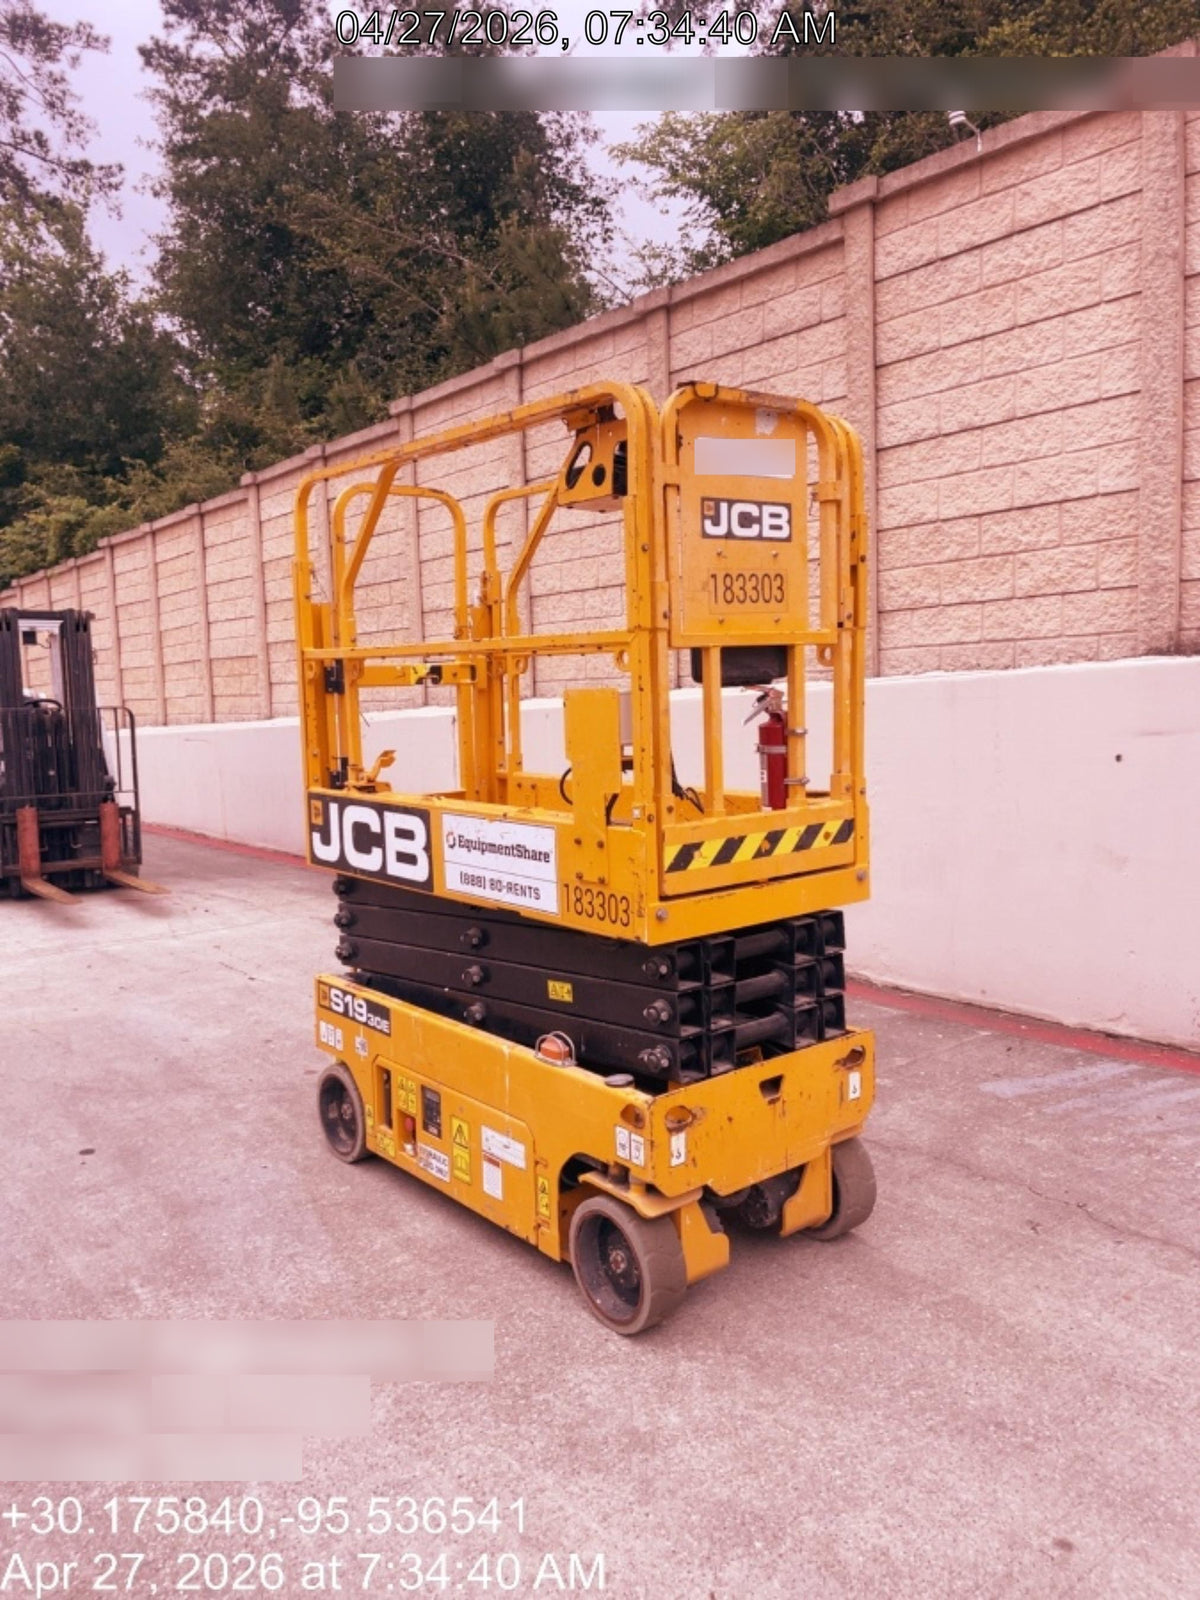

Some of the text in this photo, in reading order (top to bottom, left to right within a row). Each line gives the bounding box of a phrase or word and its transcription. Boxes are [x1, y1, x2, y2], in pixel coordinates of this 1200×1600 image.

[704, 501, 790, 538] JCB
[710, 572, 785, 604] 183303
[312, 802, 430, 882] JCB
[458, 834, 551, 863] EquipmentShare
[460, 871, 486, 890] (888)
[563, 883, 631, 927] 183303
